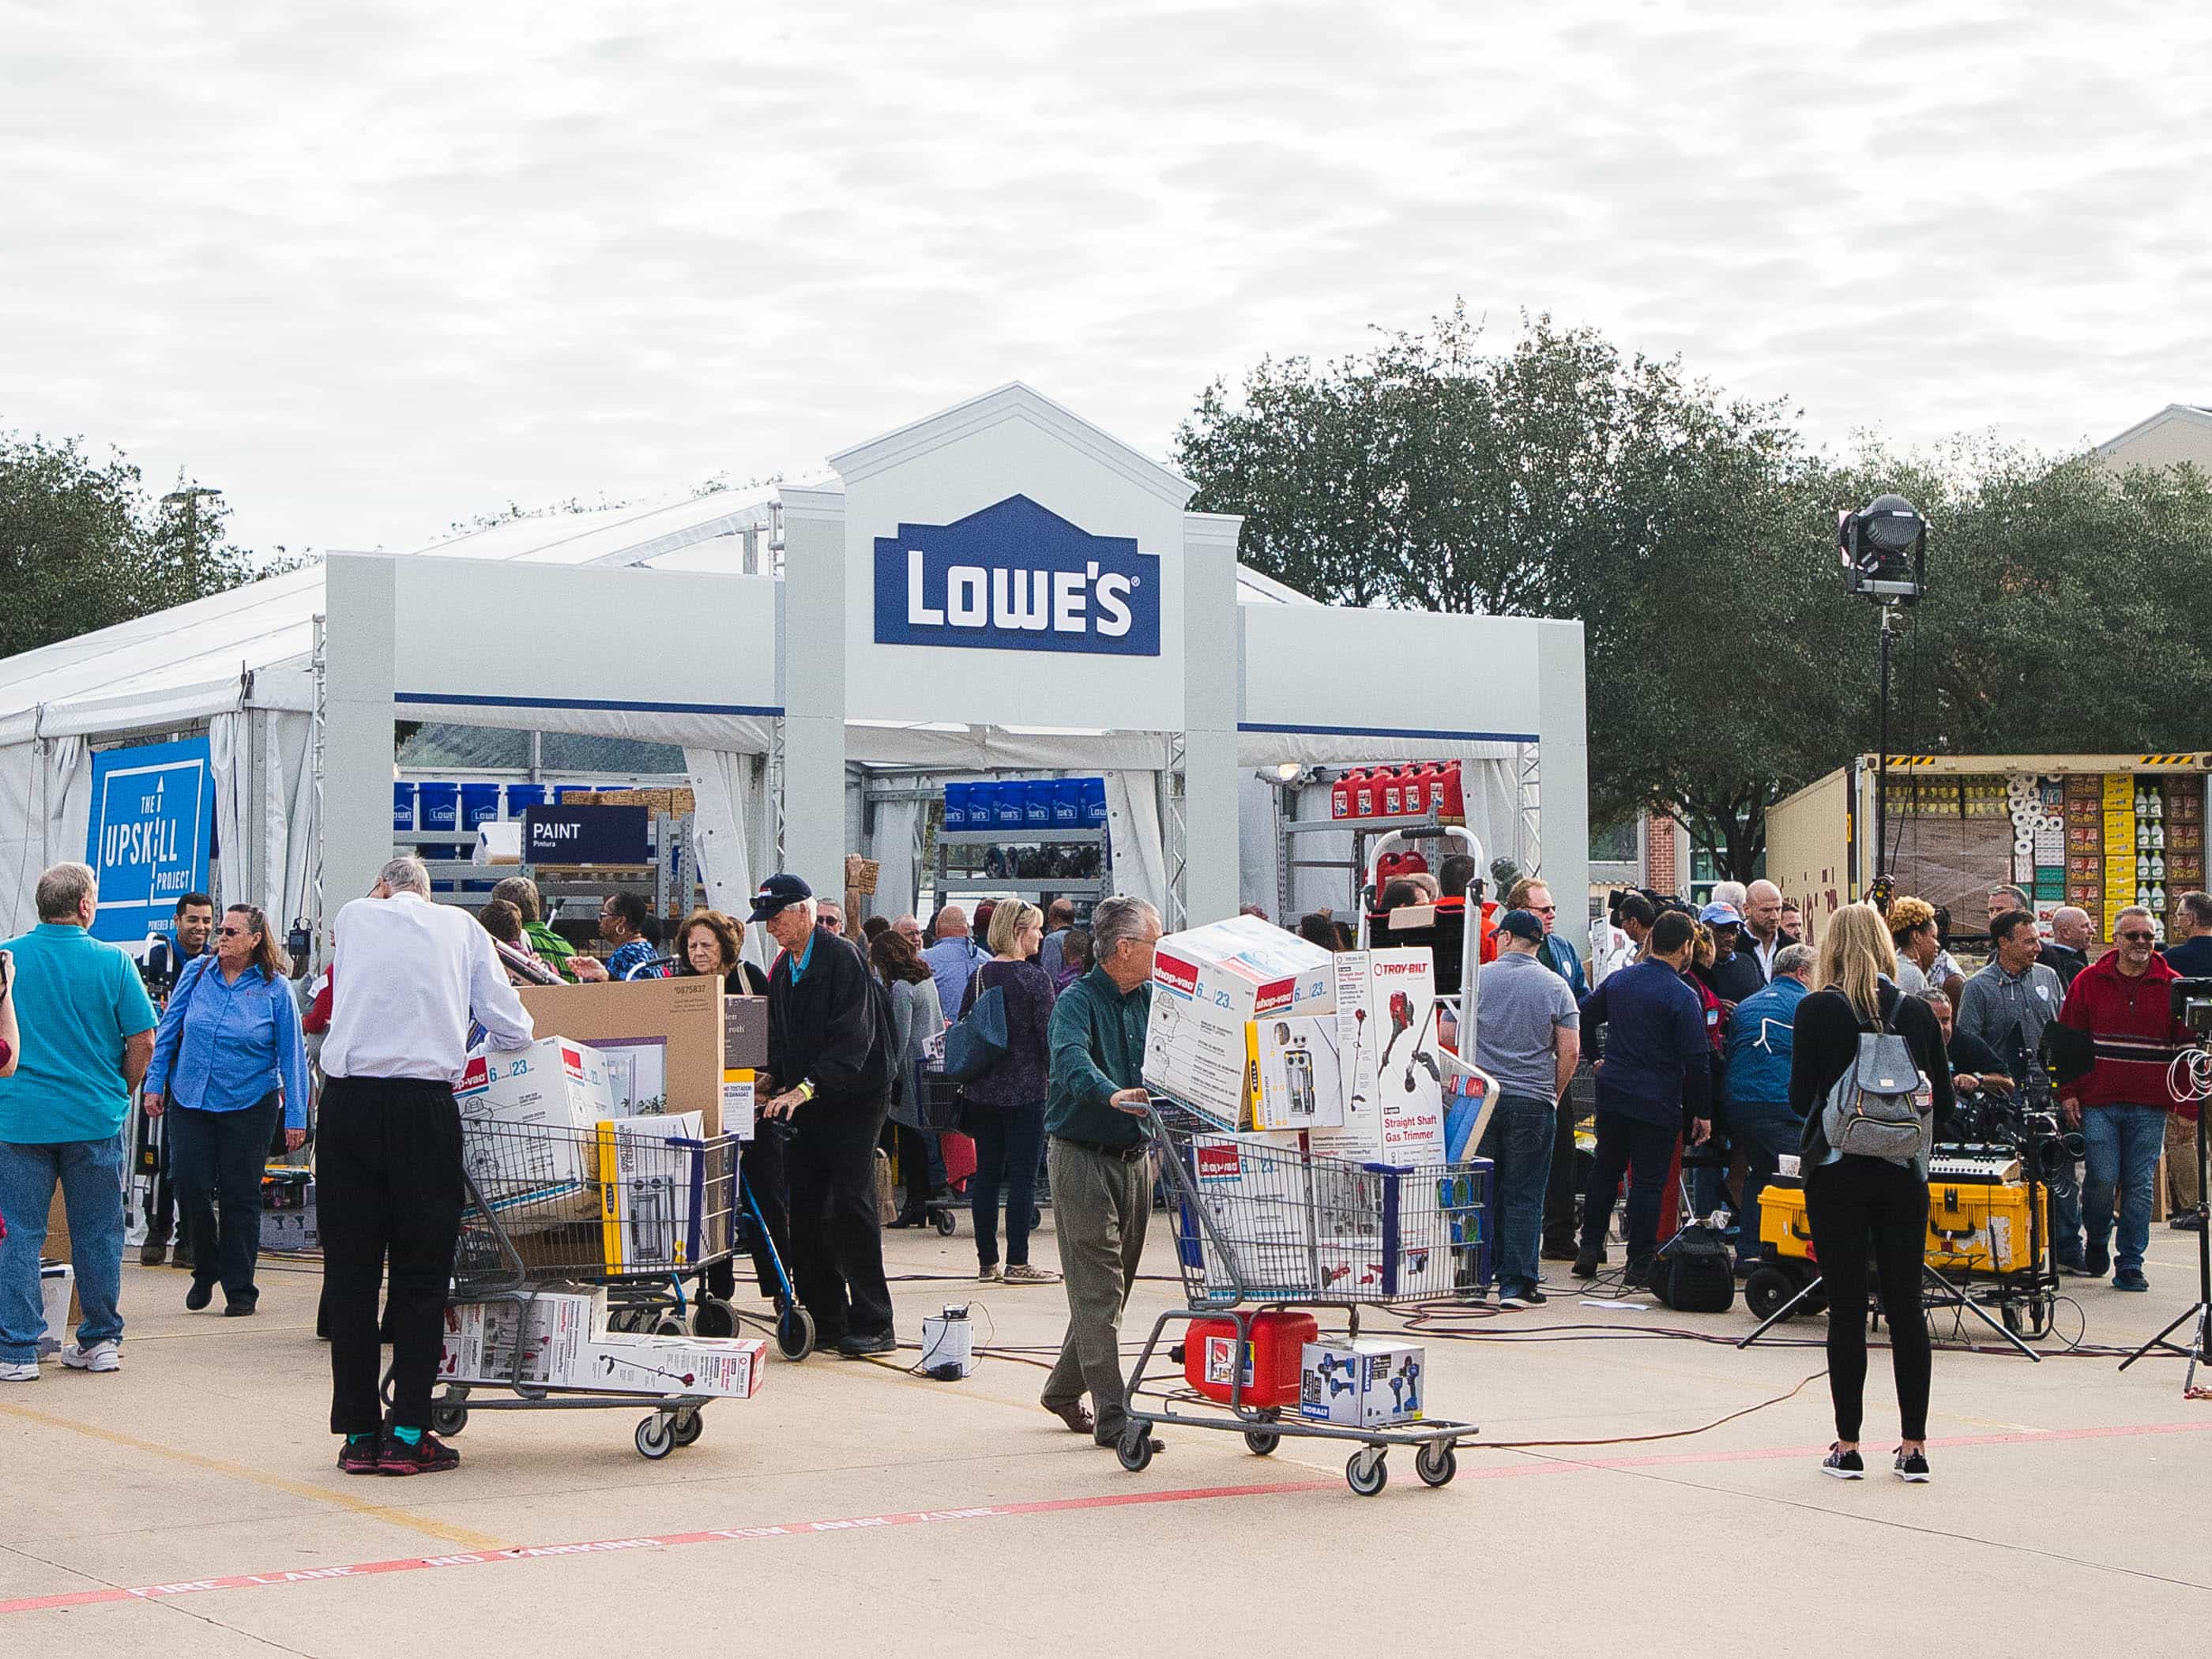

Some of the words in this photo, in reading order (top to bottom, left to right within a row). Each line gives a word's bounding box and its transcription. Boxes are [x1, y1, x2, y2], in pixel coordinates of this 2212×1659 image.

[908, 551, 1133, 638] LOWE'S
[141, 795, 155, 814] THE
[105, 817, 178, 867] UPSKILL
[533, 824, 581, 840] PAINT
[156, 871, 190, 891] PROJECT
[1382, 962, 1428, 976] TROY-BILT
[1195, 982, 1204, 998] 6
[1215, 990, 1230, 1009] 23
[1256, 993, 1292, 1010] shop-vac
[1294, 988, 1300, 1002] 6
[1311, 981, 1324, 998] 23
[453, 1072, 487, 1090] op-vac
[489, 1067, 497, 1082] 6
[512, 1059, 528, 1076] 23
[1384, 1117, 1416, 1129] Straight
[1416, 1115, 1436, 1126] Shaft
[1385, 1132, 1401, 1142] Gas
[1402, 1130, 1434, 1141] Trimmer
[1303, 1405, 1329, 1417] KOBALT
[126, 1579, 231, 1599] FIRE
[245, 1564, 368, 1583] LANE
[423, 1552, 486, 1567] NO
[498, 1539, 663, 1559] PARKING
[709, 1526, 791, 1538] TOW
[908, 1507, 1010, 1522] ZONE
